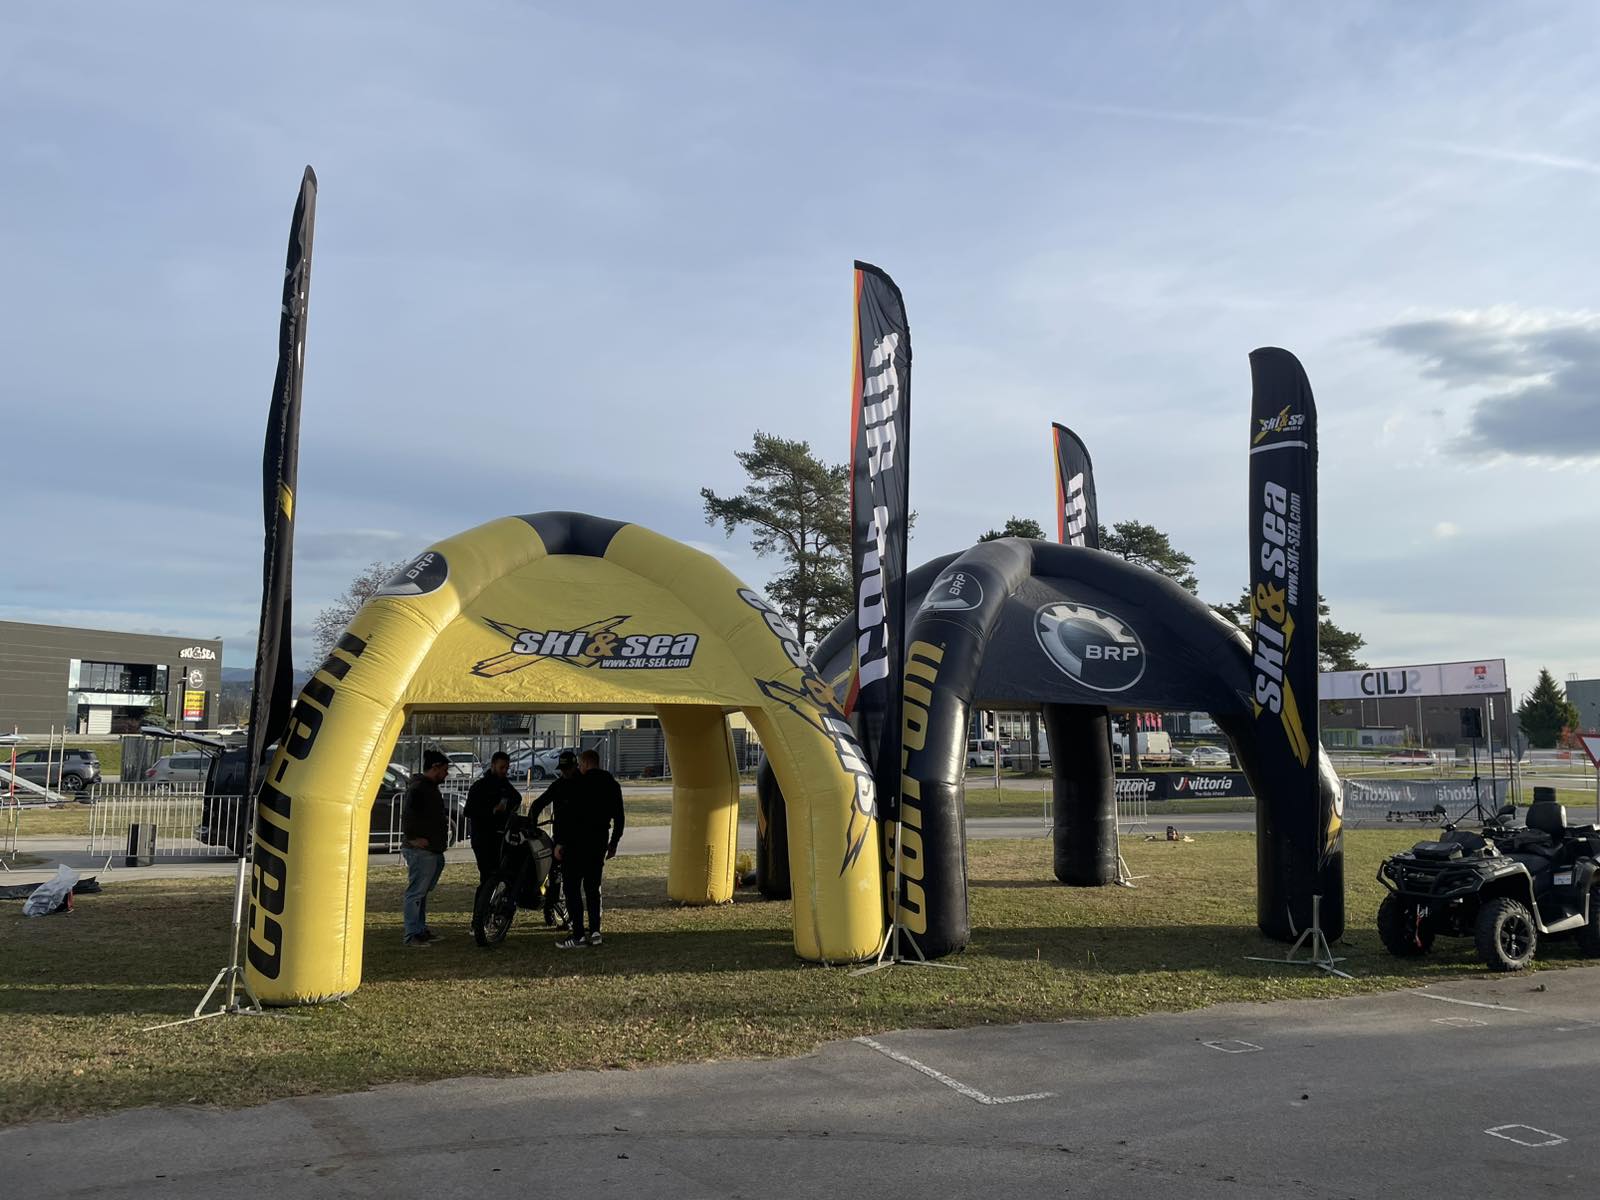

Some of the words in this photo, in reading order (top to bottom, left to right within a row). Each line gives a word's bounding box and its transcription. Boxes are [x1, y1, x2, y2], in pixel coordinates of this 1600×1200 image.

[405, 553, 434, 579] BRP
[949, 573, 966, 596] BRP
[1085, 645, 1139, 661] BRP
[602, 658, 690, 668] www.SKI-SEA.com
[1360, 671, 1407, 696] CILJ
[1188, 776, 1232, 790] vittoria
